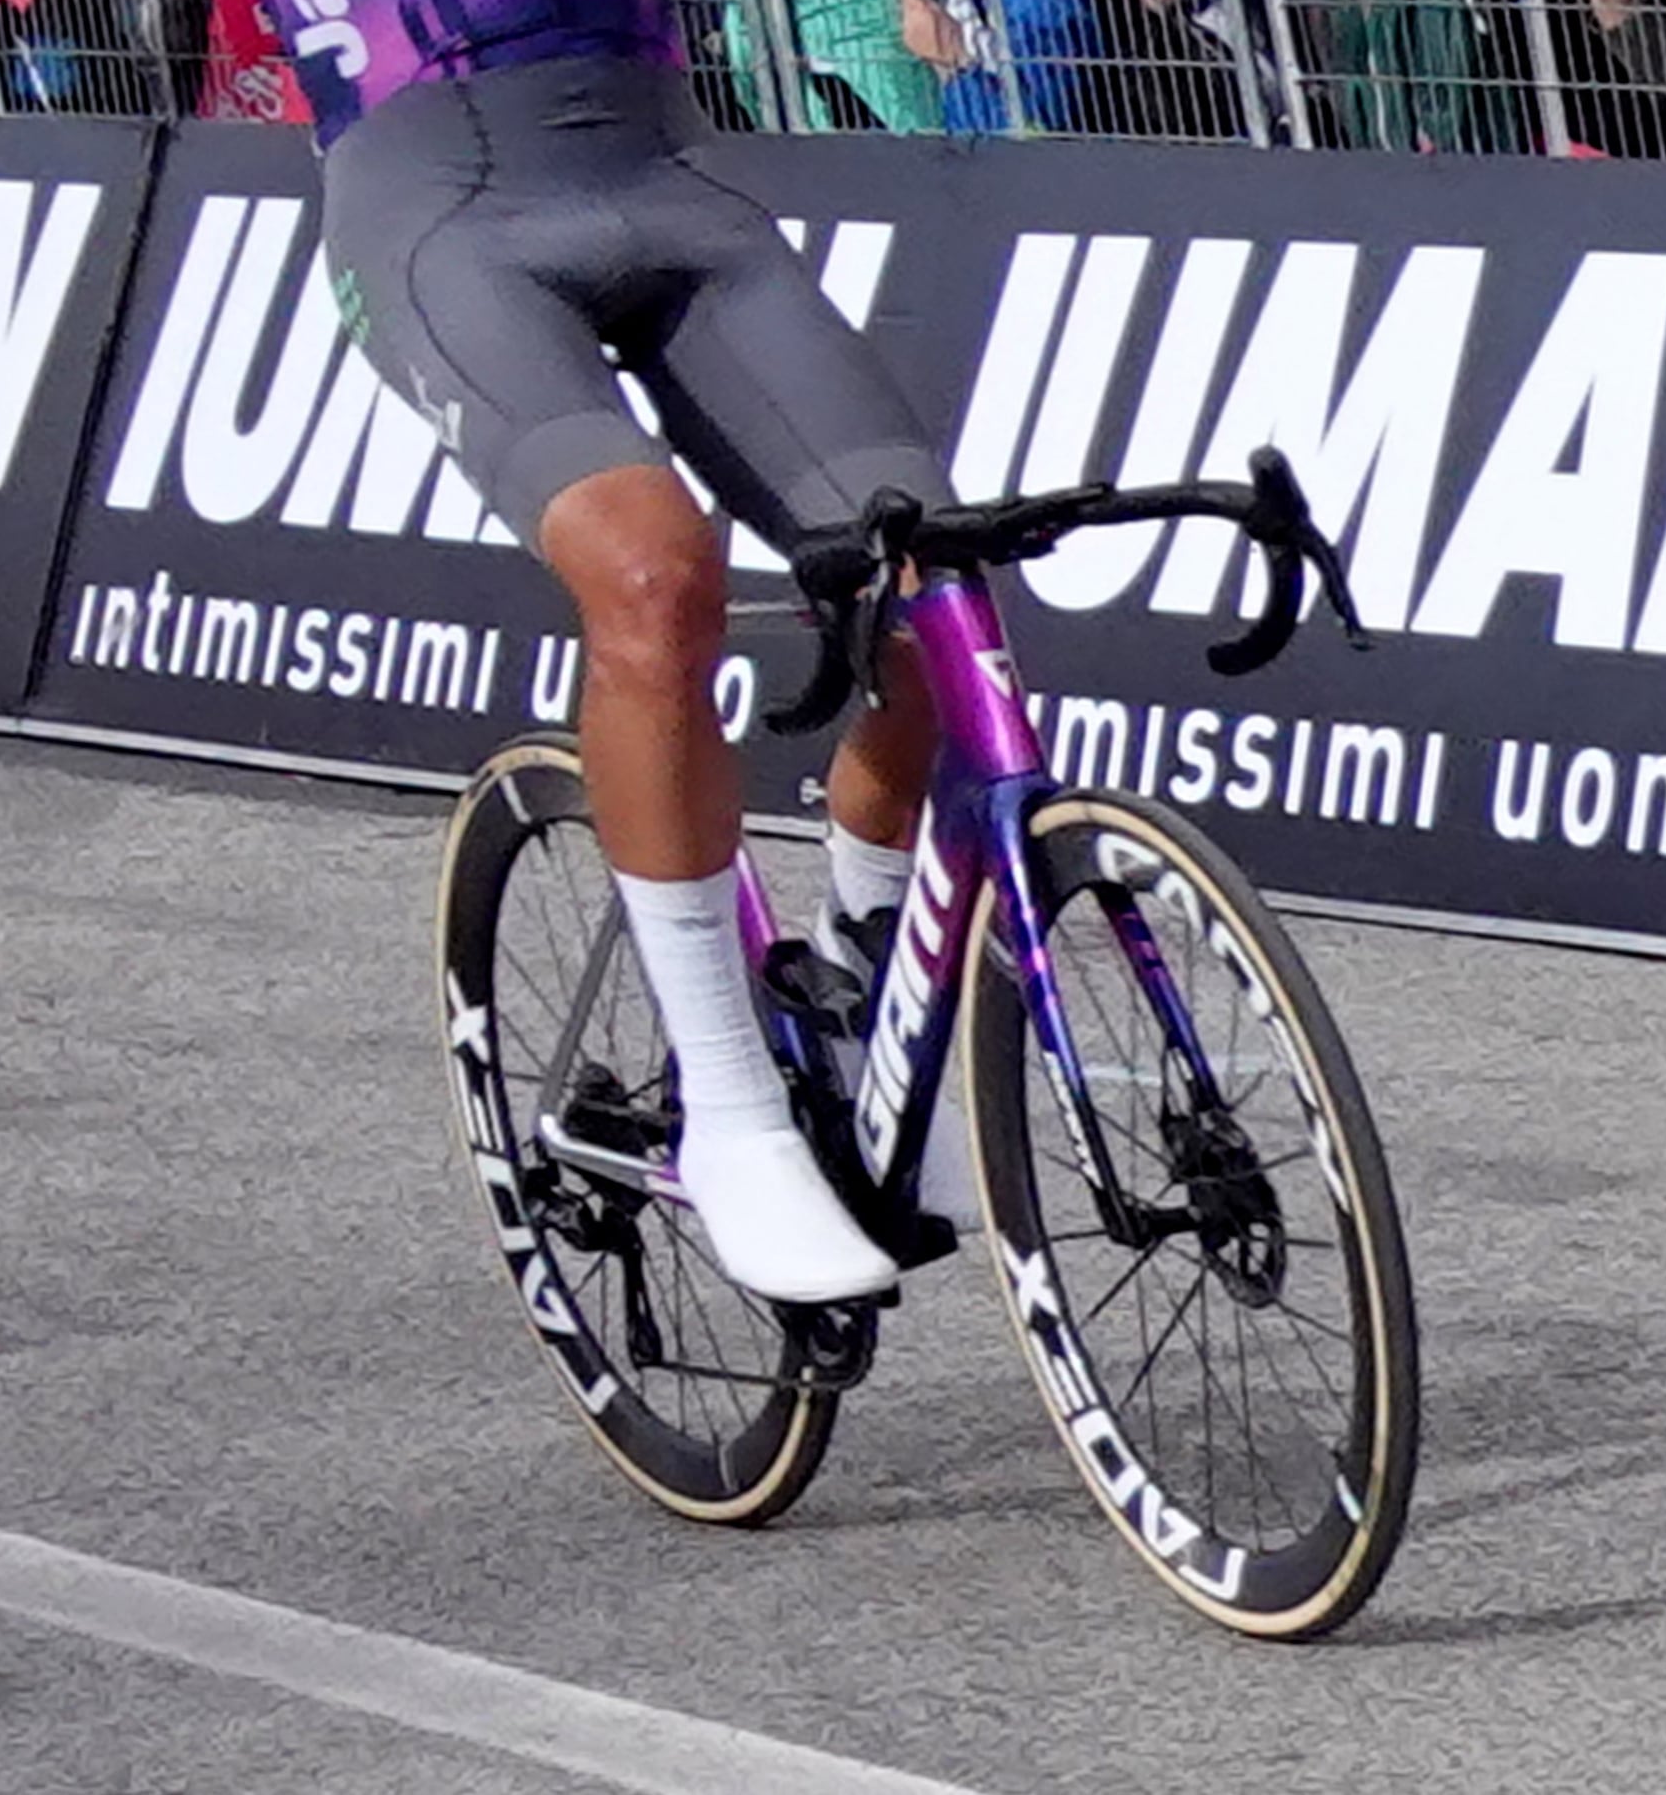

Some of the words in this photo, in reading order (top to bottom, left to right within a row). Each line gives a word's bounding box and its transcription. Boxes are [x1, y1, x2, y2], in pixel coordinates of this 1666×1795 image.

[70, 570, 500, 713] intimissimi
[531, 634, 756, 743] uo
[1025, 692, 1445, 830] missimi
